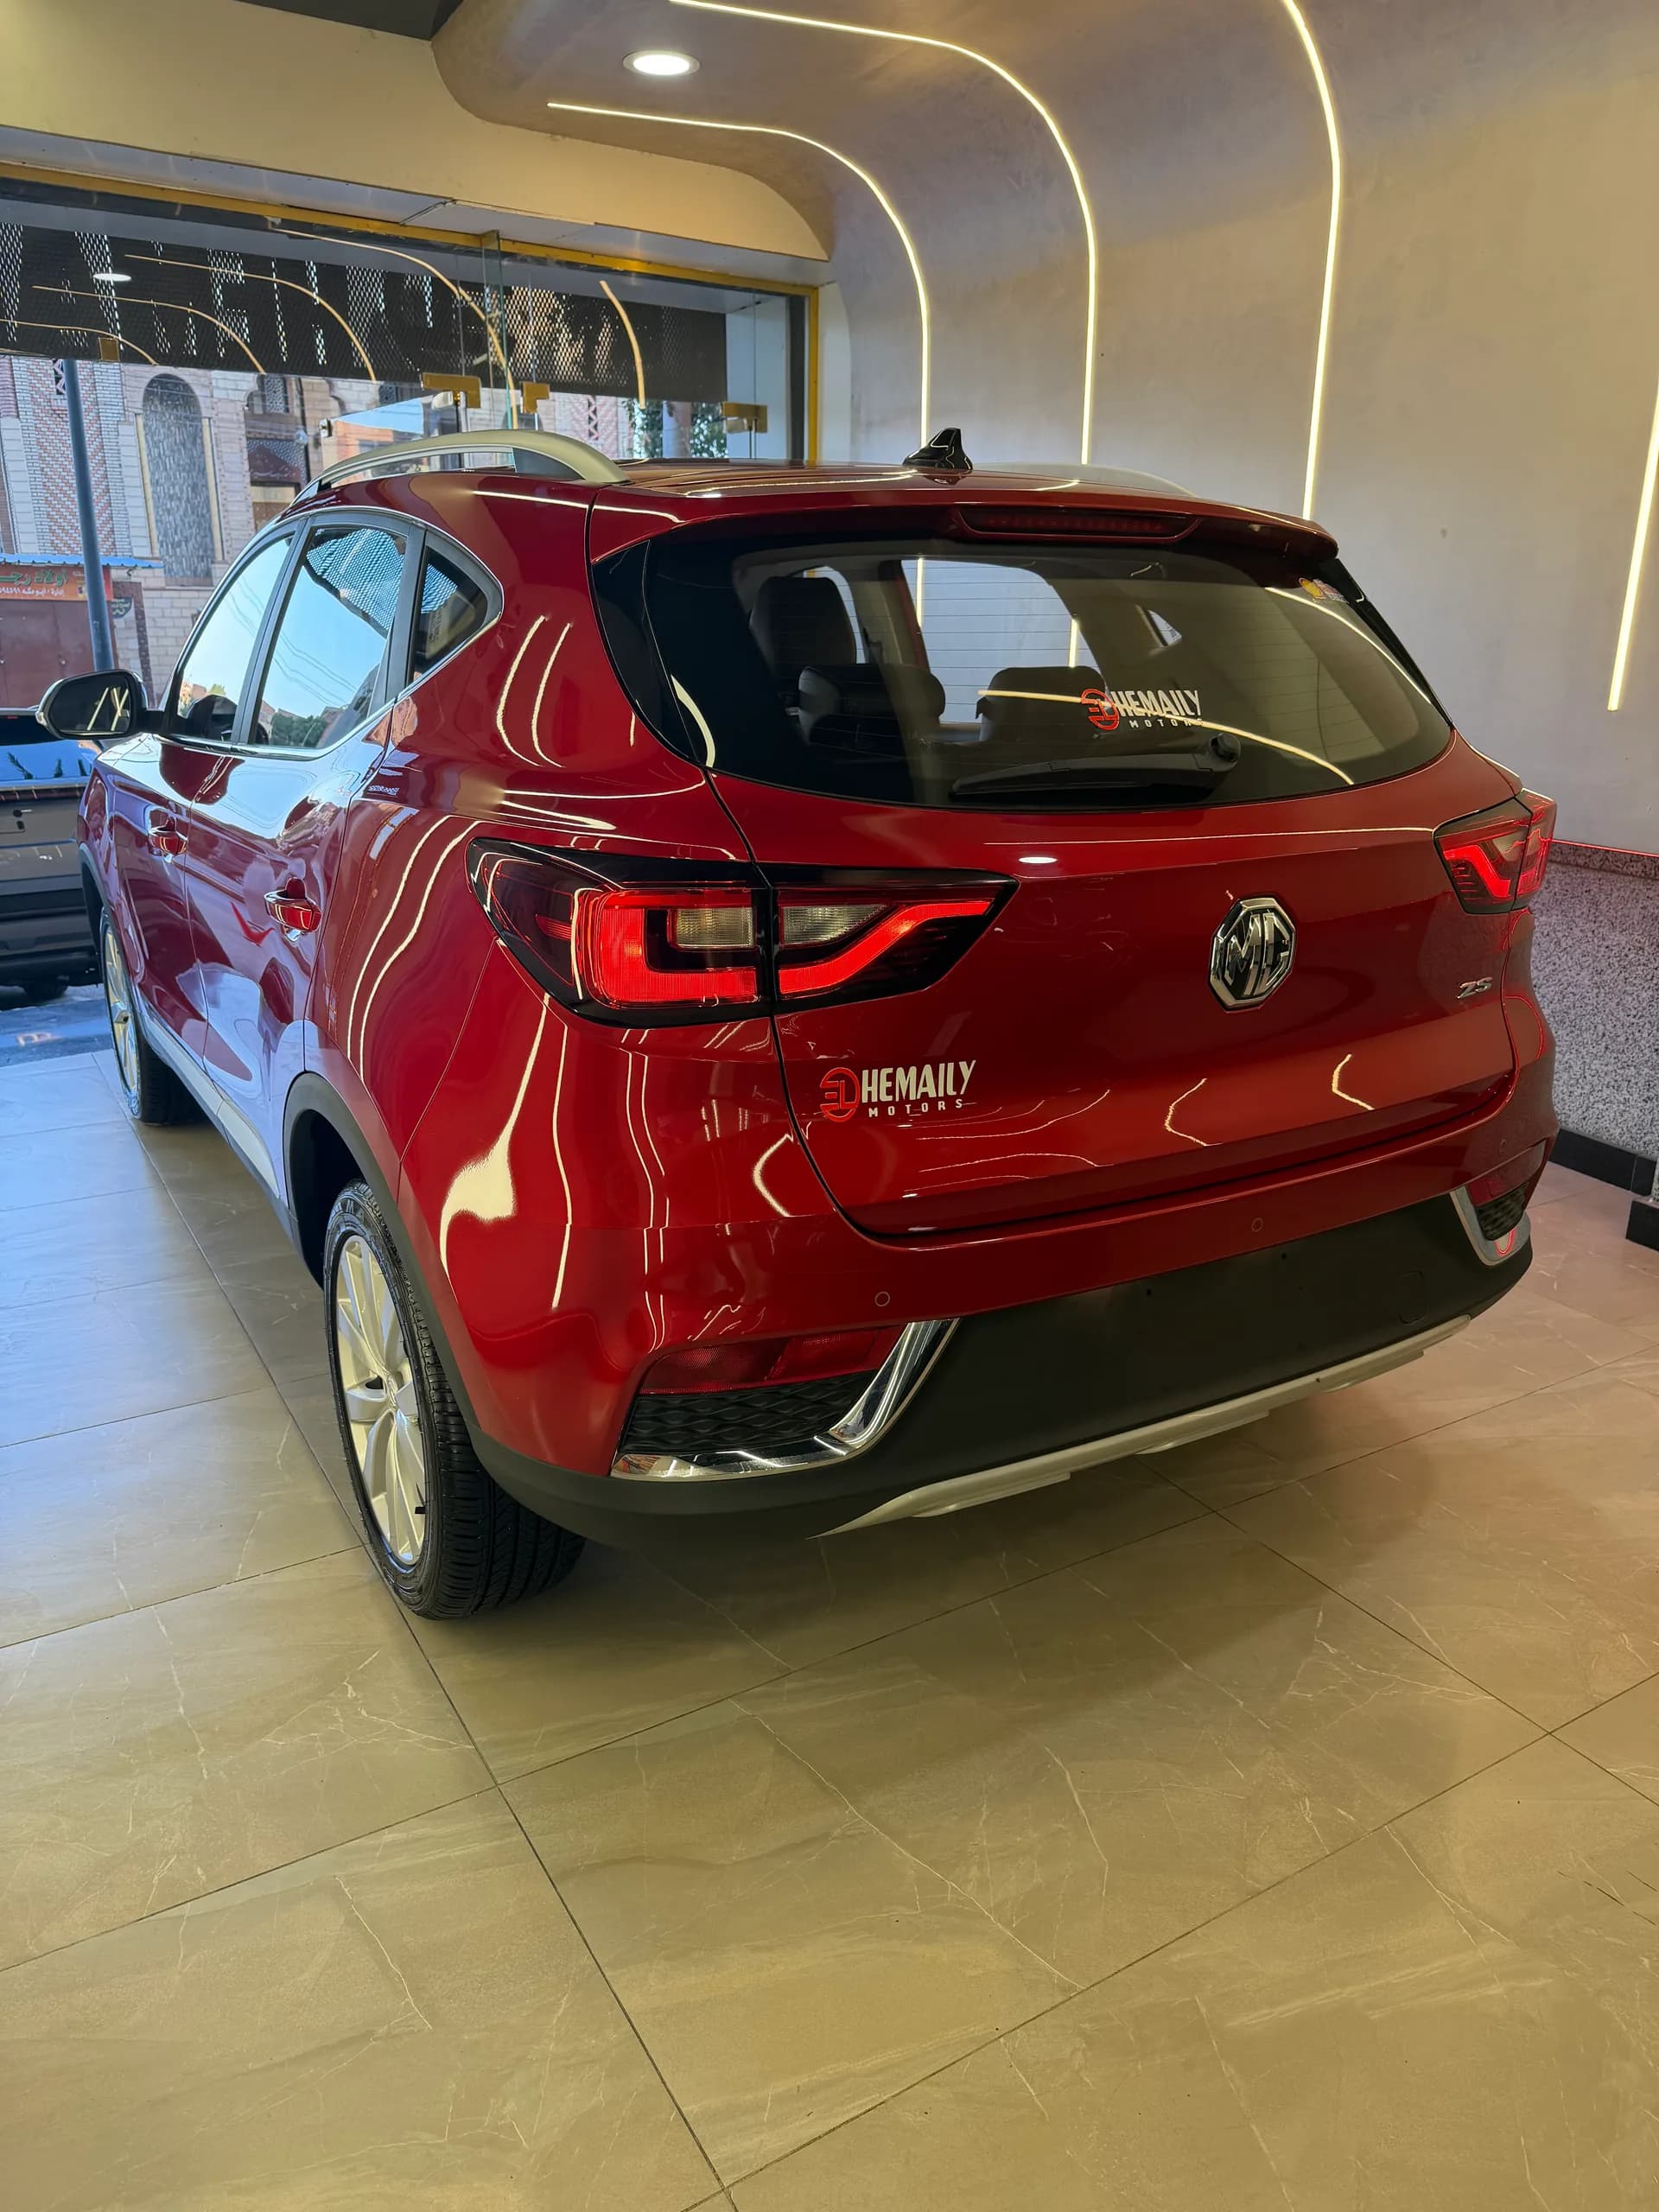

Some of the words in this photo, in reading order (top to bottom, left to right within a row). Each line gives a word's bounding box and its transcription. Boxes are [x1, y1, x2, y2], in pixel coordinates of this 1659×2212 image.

[1110, 690, 1202, 717] HEMAILY
[1222, 910, 1293, 997] MG
[1457, 977, 1493, 999] ZS
[861, 1059, 976, 1103] HEMAILY
[868, 1098, 963, 1117] MOTORS
